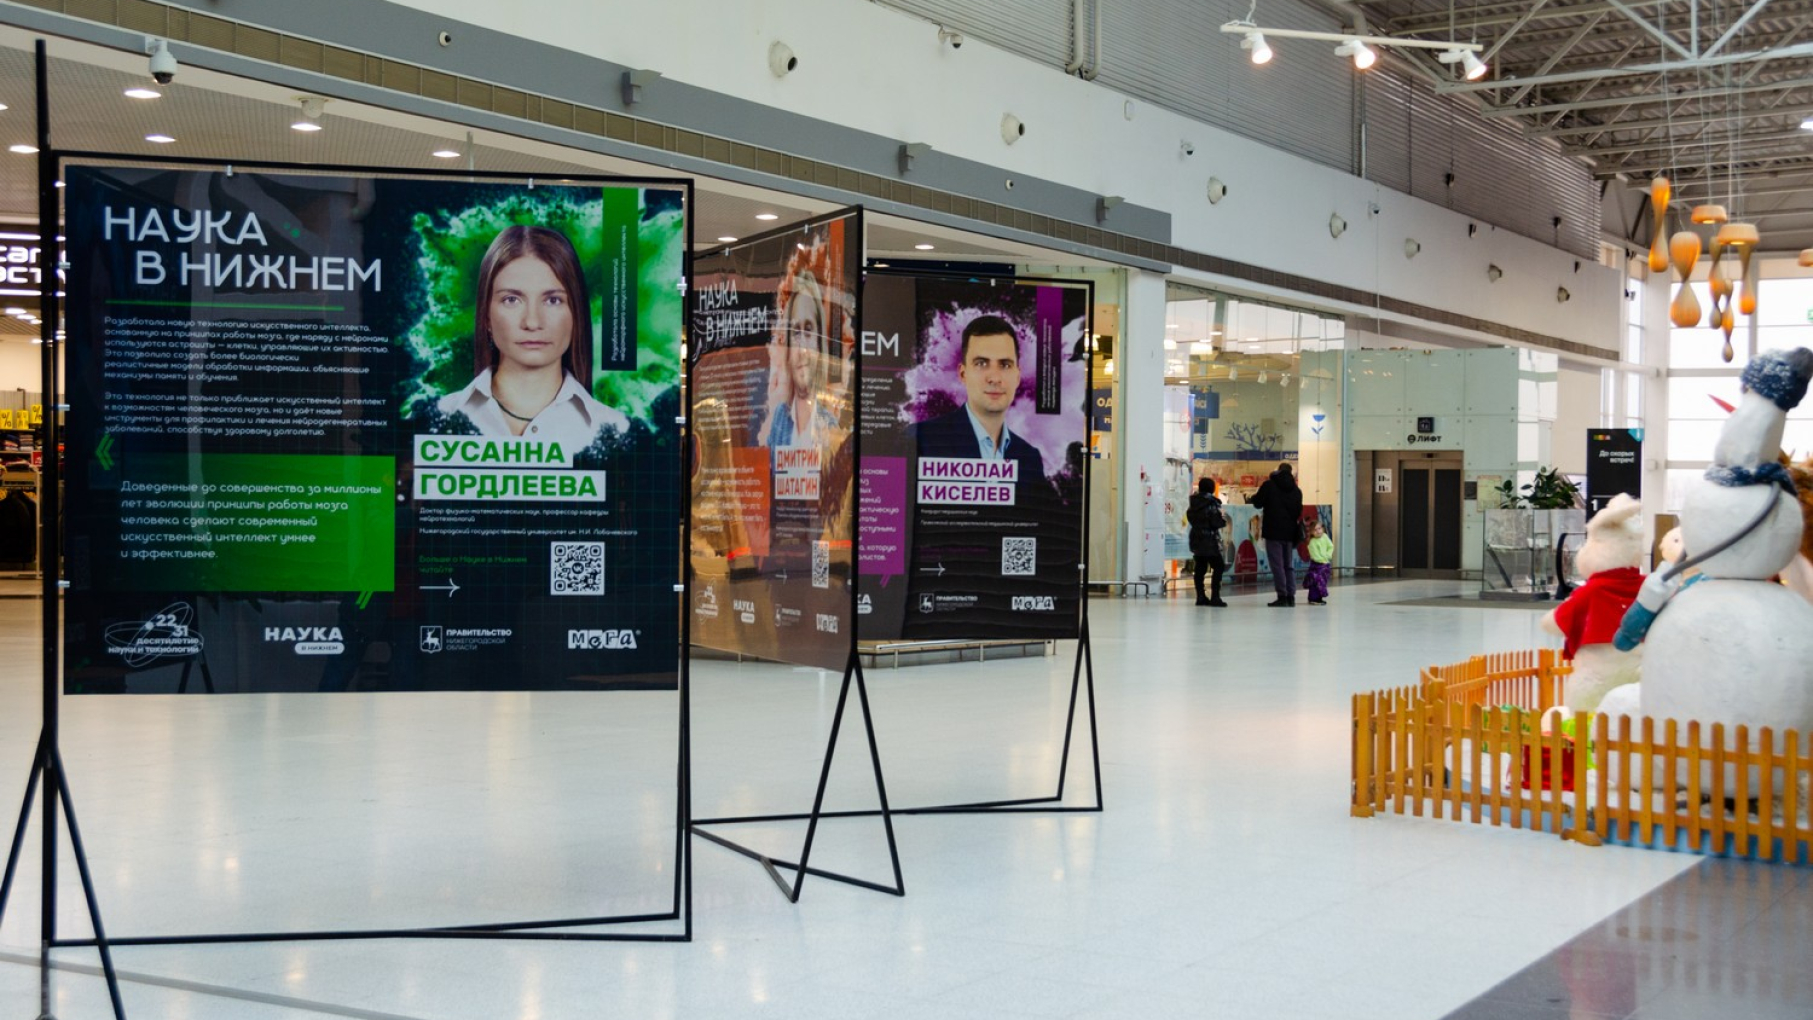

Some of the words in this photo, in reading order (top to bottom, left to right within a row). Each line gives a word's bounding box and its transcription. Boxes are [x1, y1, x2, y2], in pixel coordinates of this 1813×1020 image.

[104, 206, 268, 246] НАУКА
[137, 250, 166, 285] В
[182, 252, 382, 292] НИЖНЕМ
[700, 279, 738, 310] НАУКА
[104, 316, 166, 327] Разработала
[167, 320, 195, 328] новую
[197, 320, 248, 329] технологию
[250, 322, 318, 331] искусственного
[706, 317, 714, 342] В
[716, 306, 767, 340] НИЖНЕМ
[105, 329, 159, 338] основанную
[174, 331, 220, 339] принципах
[222, 331, 256, 340] работы
[286, 334, 300, 342] где
[302, 335, 333, 343] наряду
[342, 334, 388, 343] нейронами
[104, 340, 166, 349] используются
[168, 341, 216, 349] астроциты
[260, 344, 318, 352] управляющие
[104, 349, 122, 357] Это
[124, 350, 171, 359] позволило
[173, 352, 208, 360] создать
[210, 352, 238, 360] более
[239, 353, 300, 361] биологически
[104, 361, 168, 369] реалистичные
[170, 362, 204, 370] модели
[205, 362, 252, 372] обработки
[312, 365, 370, 374] объясняющие
[104, 372, 153, 380] механизмы
[104, 392, 122, 400] Это
[125, 392, 174, 401] технология
[221, 394, 274, 404] приближает
[276, 396, 340, 405] искусственный
[104, 415, 162, 423] инструменты
[182, 416, 246, 424] профилактики
[167, 426, 222, 434] способствуя
[225, 427, 272, 436] здоровому
[420, 440, 565, 463] СУСАННА
[922, 458, 1014, 478] НИКОЛАЙ
[120, 480, 198, 494] Доведенные
[201, 482, 217, 496] до
[220, 484, 304, 494] совершенства
[308, 485, 321, 496] за
[324, 485, 381, 494] миллионы
[420, 474, 598, 499] ГОРДЛЕЕВА
[777, 476, 818, 496] ШАТАГИН
[922, 486, 1010, 502] КИСЕЛЕВ
[120, 500, 142, 508] лет
[146, 500, 204, 510] эволюции
[207, 500, 265, 511] принципы
[268, 499, 312, 512] работы
[315, 502, 348, 512] мозга
[120, 516, 180, 526] человека
[183, 517, 234, 528] сделают
[238, 516, 318, 528] современный
[120, 532, 212, 544] искусственный
[215, 534, 277, 542] интеллект
[280, 534, 316, 545] умнее
[120, 550, 128, 558] и
[132, 548, 218, 560] эффективнее.
[156, 614, 177, 627] 22
[172, 626, 189, 637] 31
[264, 627, 344, 642] НАУКА
[136, 637, 199, 646] десятилетие
[108, 646, 136, 655] науки
